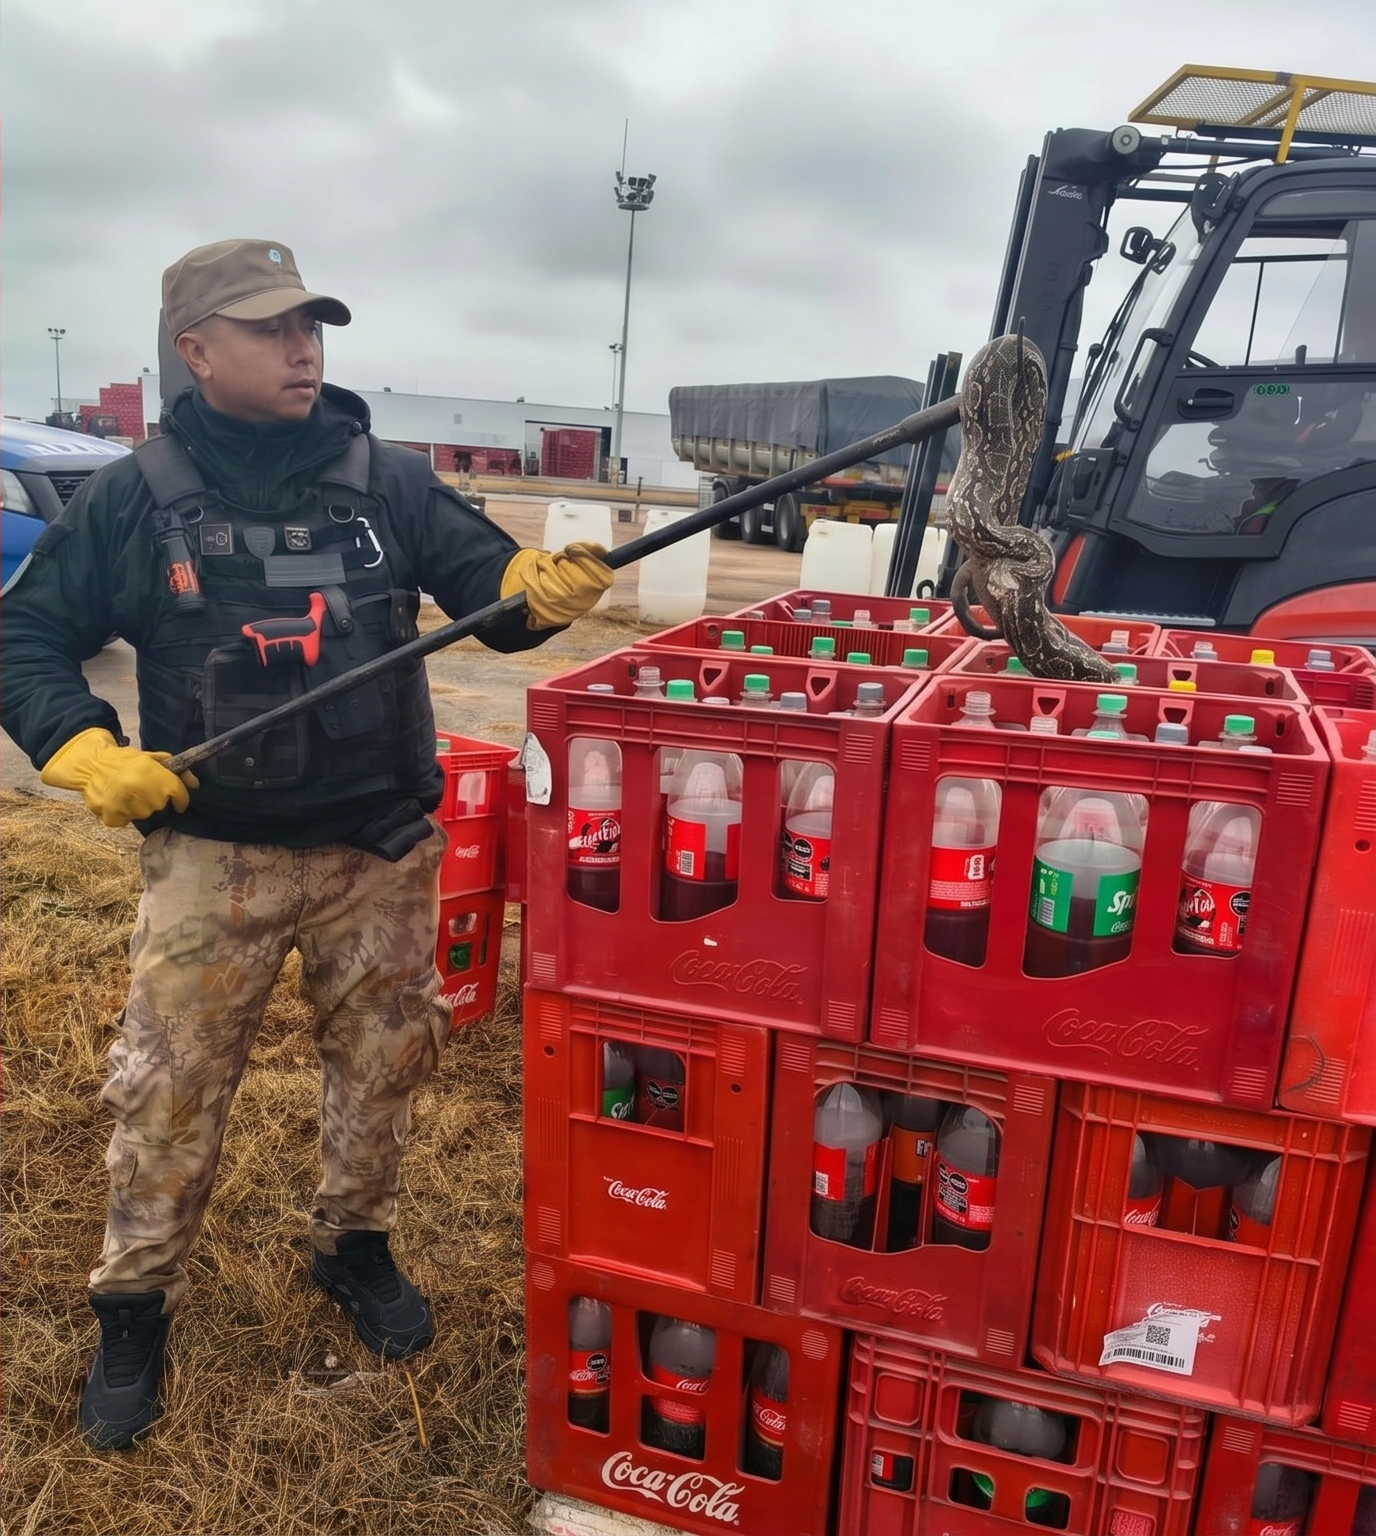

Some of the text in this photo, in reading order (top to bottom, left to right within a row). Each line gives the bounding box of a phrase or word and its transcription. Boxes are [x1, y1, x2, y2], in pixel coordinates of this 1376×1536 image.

[669, 949, 808, 1002] Coca-Cola
[1041, 1007, 1210, 1066] Coca-Cola
[608, 1181, 670, 1210] Coca-Cola
[840, 1276, 948, 1320] Coca-Cola
[601, 1451, 746, 1523] Coca-Cola
